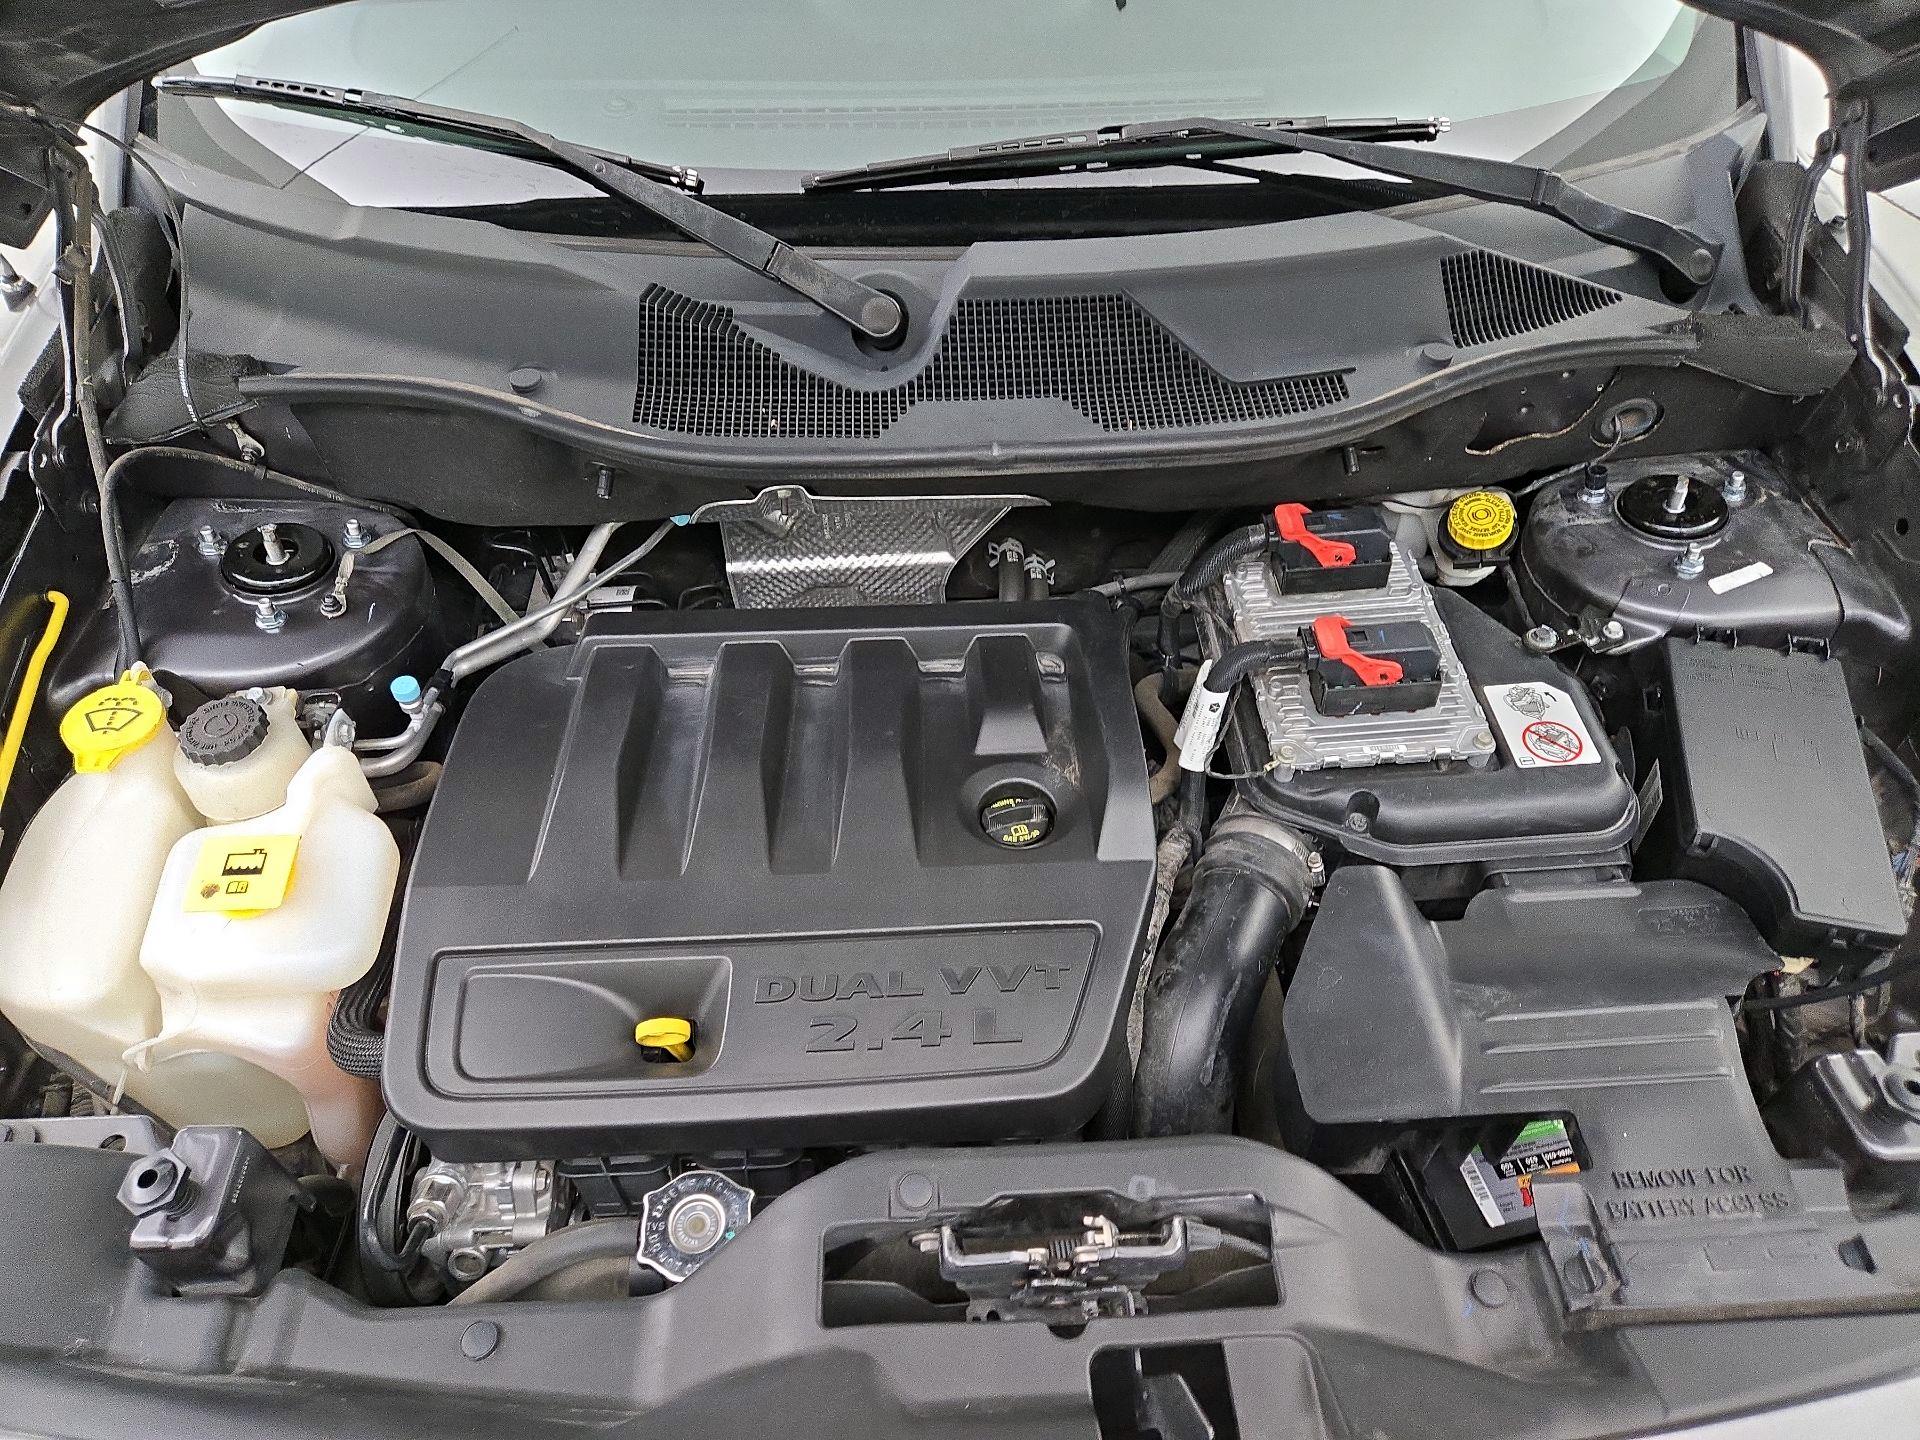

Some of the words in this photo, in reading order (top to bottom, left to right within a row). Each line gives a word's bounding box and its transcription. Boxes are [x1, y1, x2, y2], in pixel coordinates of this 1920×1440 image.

[755, 970, 924, 1004] DUAL
[938, 962, 1071, 996] VVT
[1611, 1168, 1697, 1190] REMOVE
[1705, 1165, 1752, 1185] FOR
[1605, 1198, 1696, 1219] BATTERY
[1705, 1192, 1789, 1215] ACCESS
